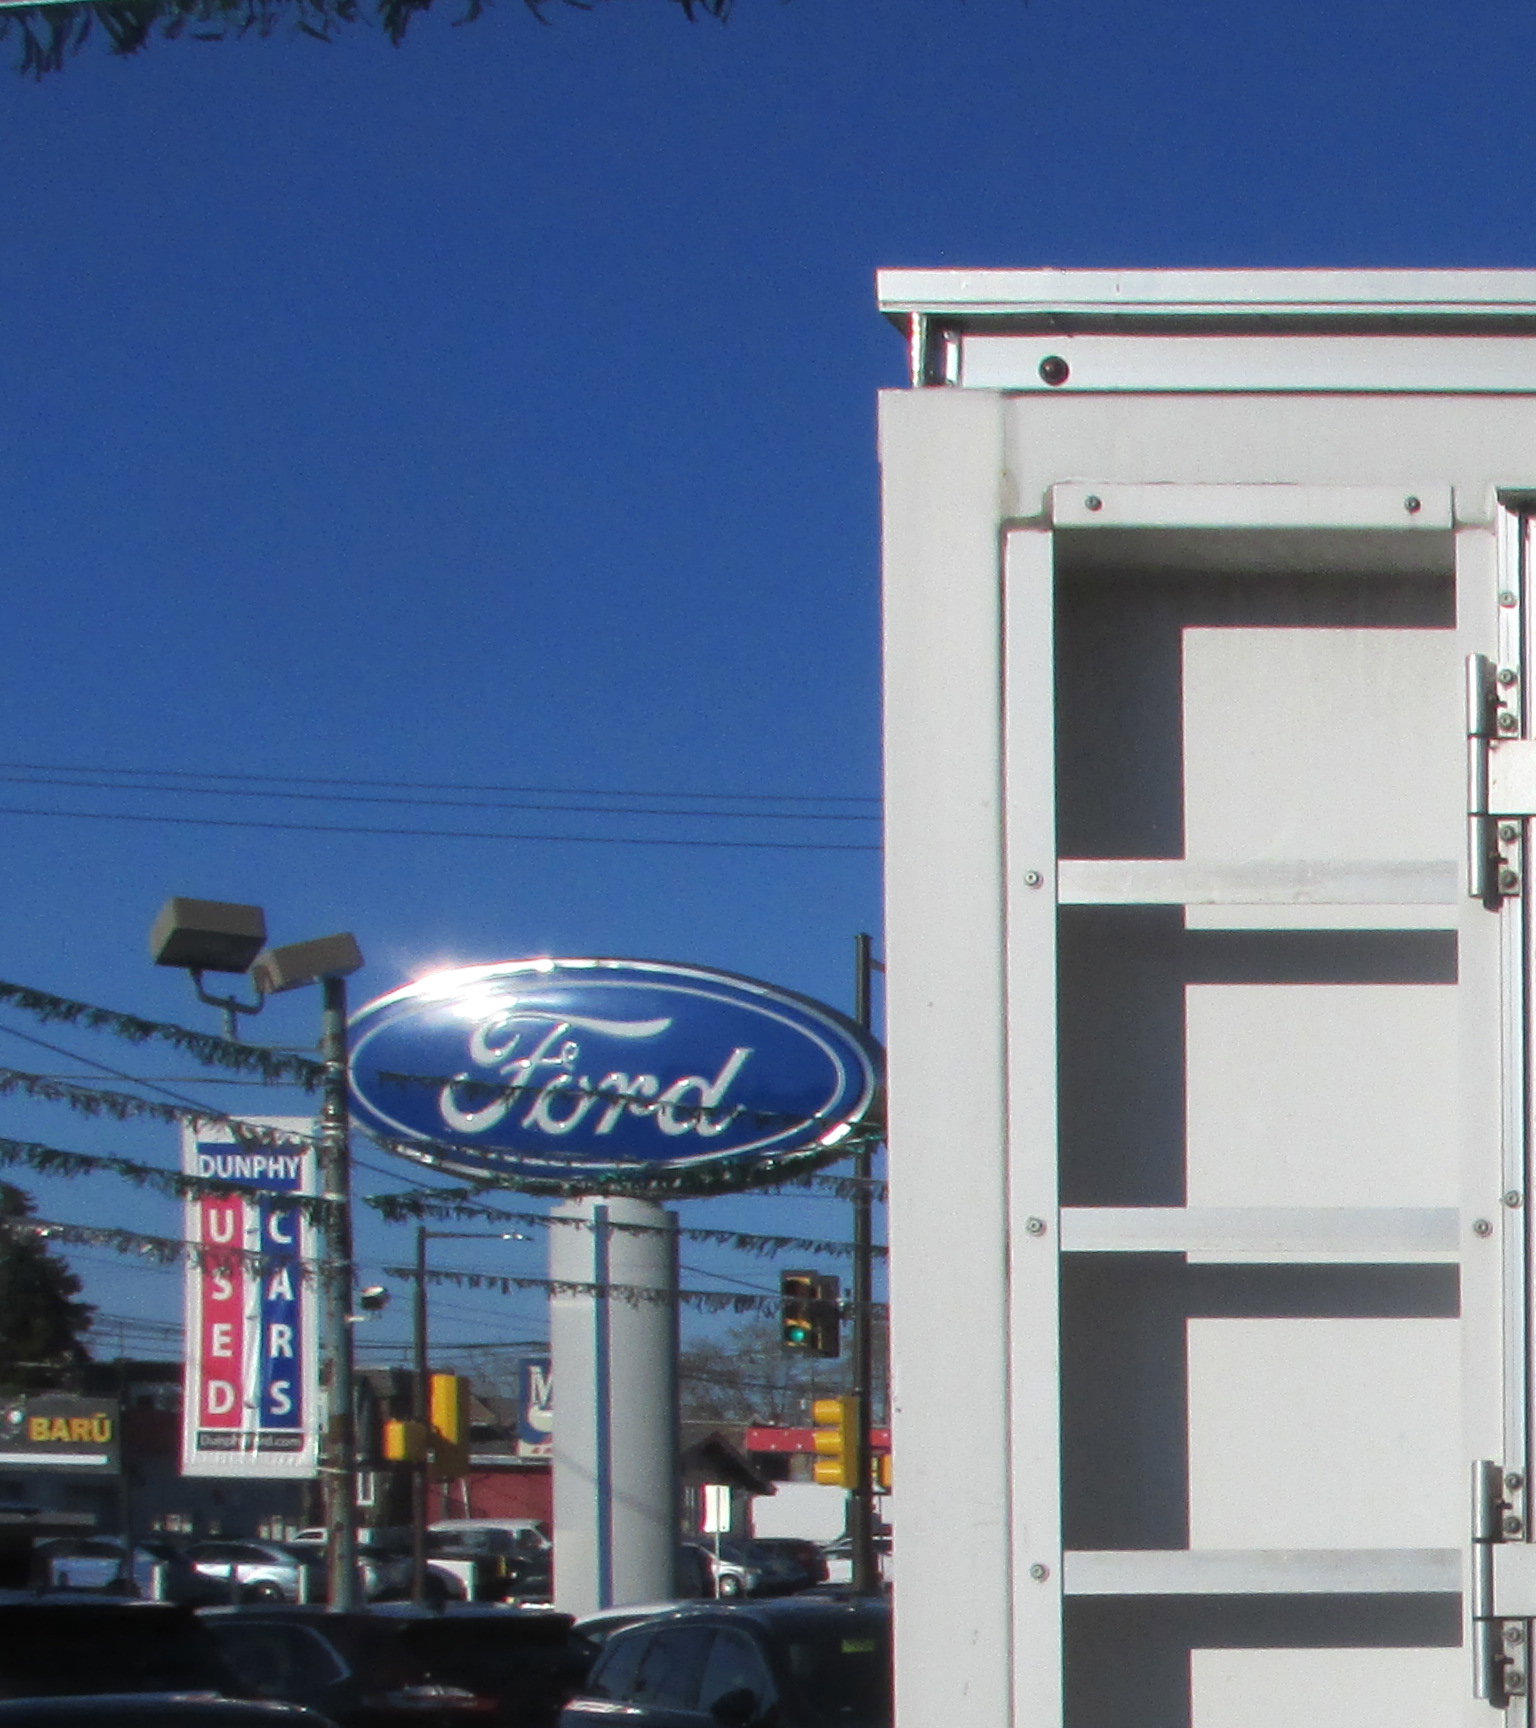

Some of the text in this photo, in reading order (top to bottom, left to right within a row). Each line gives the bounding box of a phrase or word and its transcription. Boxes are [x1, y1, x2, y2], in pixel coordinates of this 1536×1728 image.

[440, 1009, 754, 1136] Ford
[200, 1154, 300, 1180] DUNPHY
[207, 1208, 236, 1416] USED
[267, 1209, 294, 1416] CARS
